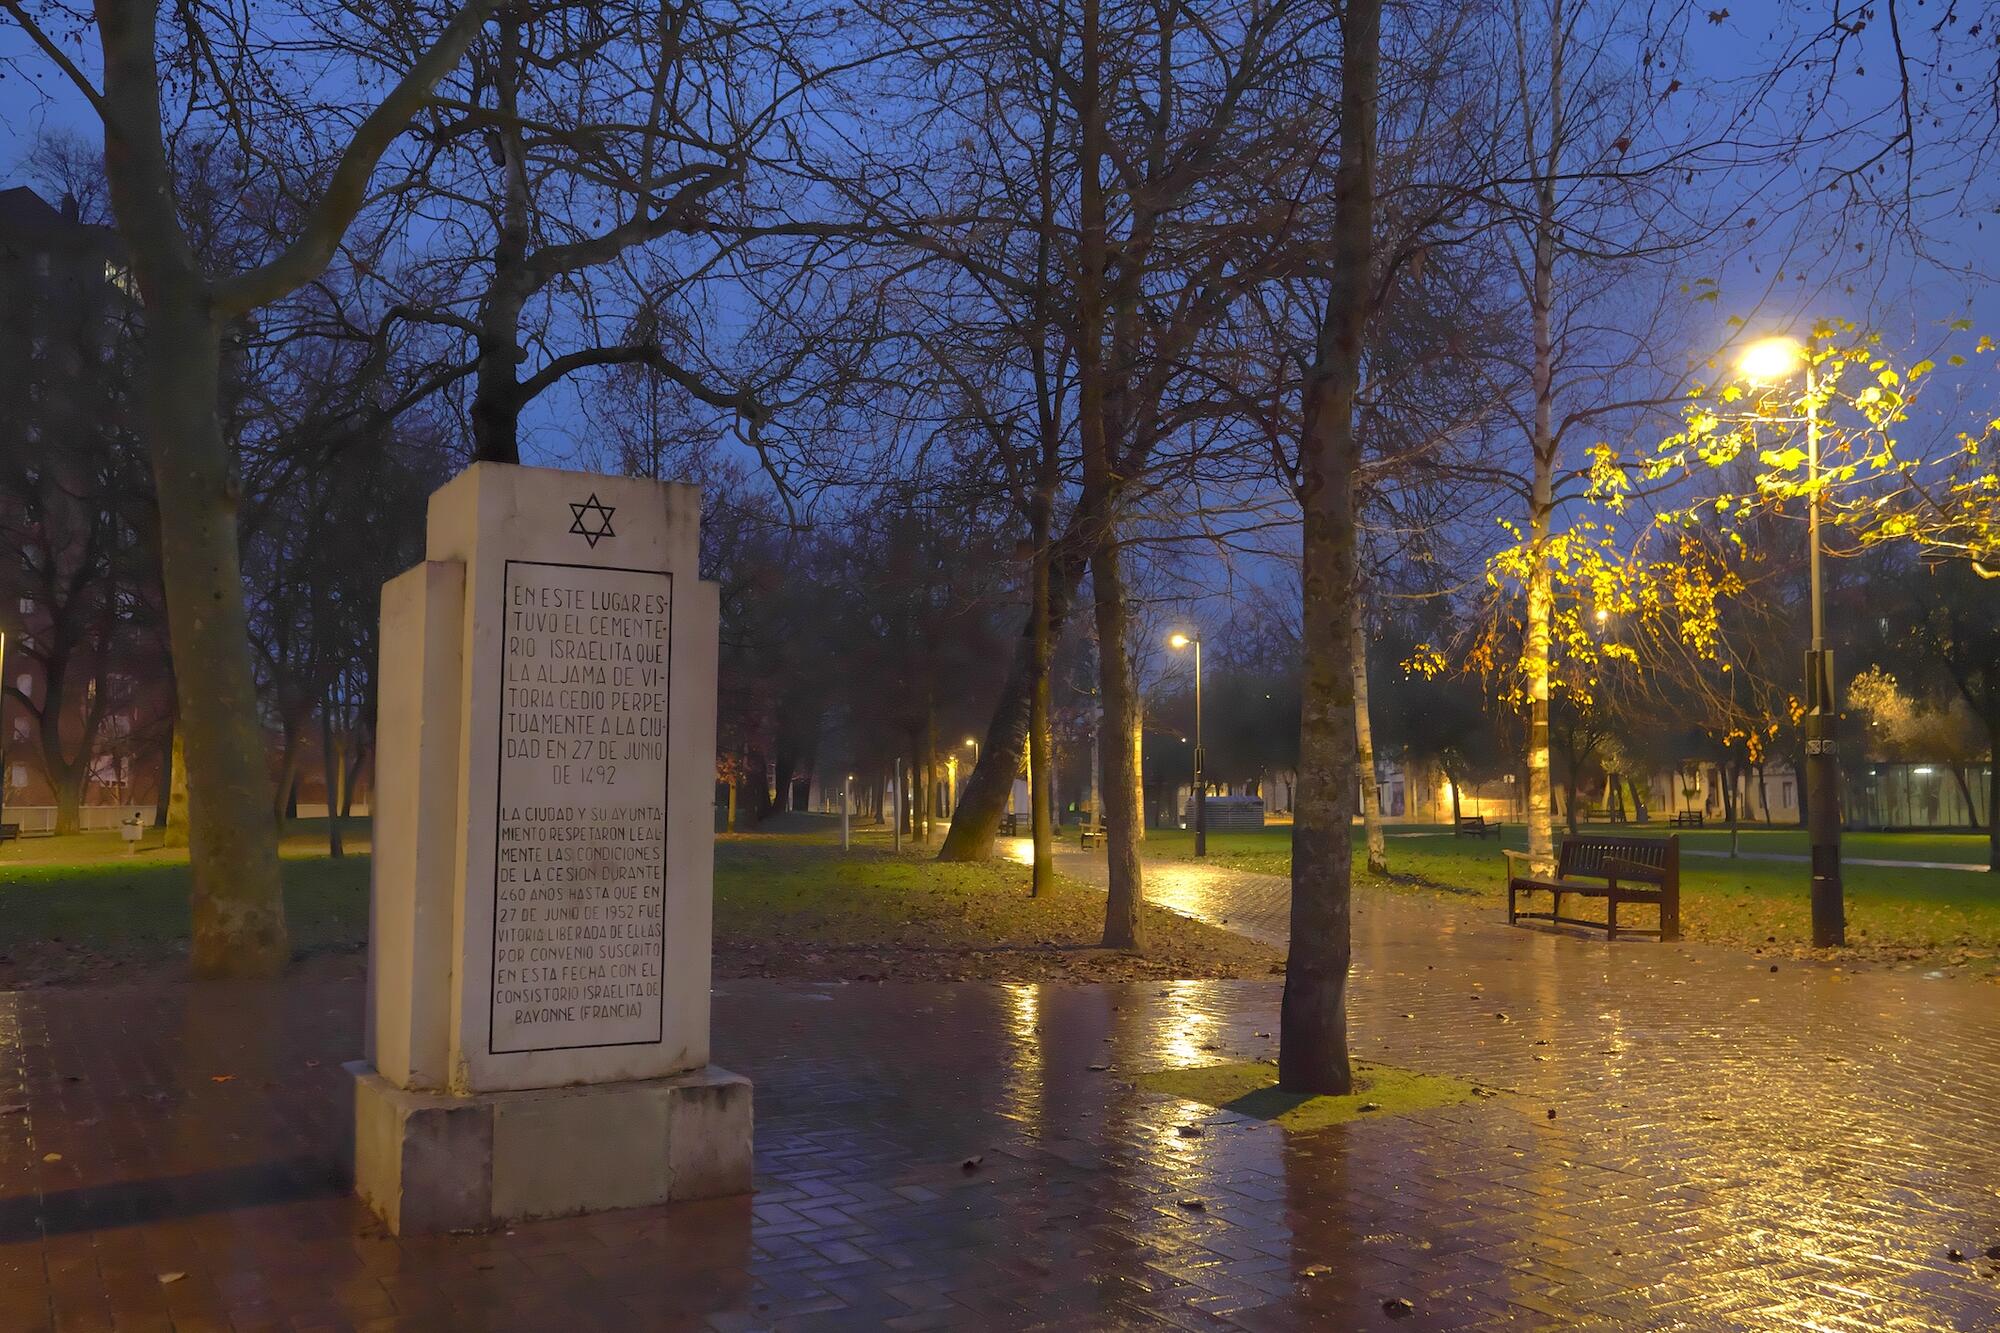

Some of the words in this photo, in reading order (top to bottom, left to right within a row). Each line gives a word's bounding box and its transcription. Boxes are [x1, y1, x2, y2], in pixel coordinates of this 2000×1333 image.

[514, 586, 535, 605] EN
[542, 588, 584, 609] ESTE
[591, 591, 640, 613] LUGAR
[513, 612, 557, 632] TUVO
[565, 615, 584, 634] EL
[510, 637, 535, 657] RIO
[550, 640, 631, 662] ISRAELITA
[637, 643, 664, 664] QUE
[509, 663, 529, 682] LA
[537, 664, 606, 685] ALJAMA
[613, 667, 634, 686] DE
[509, 688, 553, 707] TORIA
[560, 690, 605, 709] CEDIO
[508, 713, 594, 734] TUAMENTE
[601, 717, 610, 734] A
[616, 717, 635, 735] LA
[507, 739, 540, 758] DAD
[547, 740, 566, 759] EN
[572, 740, 593, 759] 27
[599, 741, 617, 759] DE
[624, 742, 662, 760] JUNIO
[553, 765, 570, 784] DE
[581, 766, 616, 785] 1492
[502, 808, 520, 821] LA
[525, 808, 573, 821] CIUDAD
[578, 808, 586, 821] Y
[592, 808, 606, 821] SU
[502, 827, 546, 841] MIENTO
[550, 827, 625, 841] RESPETARON
[502, 847, 542, 862] MENTE
[547, 848, 571, 861] LAS
[578, 847, 660, 861] CONDICIONES
[501, 868, 516, 882] DE
[524, 868, 541, 881] LA
[547, 867, 596, 881] CESION
[602, 865, 660, 880] DURANTE
[501, 888, 525, 901] 460
[570, 886, 609, 900] HASTA
[614, 886, 637, 899] QUE
[643, 886, 660, 898] EN
[500, 908, 517, 922] 27
[522, 908, 536, 921] DE
[544, 907, 579, 921] JUNIO
[584, 906, 598, 920] DE
[605, 905, 633, 920] 1952
[639, 904, 660, 918] FUE
[498, 928, 543, 942] VITORIA
[548, 926, 606, 941] LIBERADA
[610, 925, 622, 938] DE
[627, 923, 661, 938] ELLAS
[499, 949, 524, 962] POR
[531, 946, 593, 961] CONVENIO
[600, 943, 660, 959] SUSCRITO
[498, 969, 516, 984] EN
[522, 968, 556, 983] ESTA
[562, 965, 605, 980] FECHA
[611, 964, 636, 978] CON
[642, 963, 656, 977] EL
[497, 987, 578, 1004] CONSISTORIO
[584, 984, 643, 999] ISRAELITA
[647, 982, 659, 996] DE
[516, 1007, 575, 1024] BAYONNE
[580, 1002, 642, 1021] (FRANCIA)
